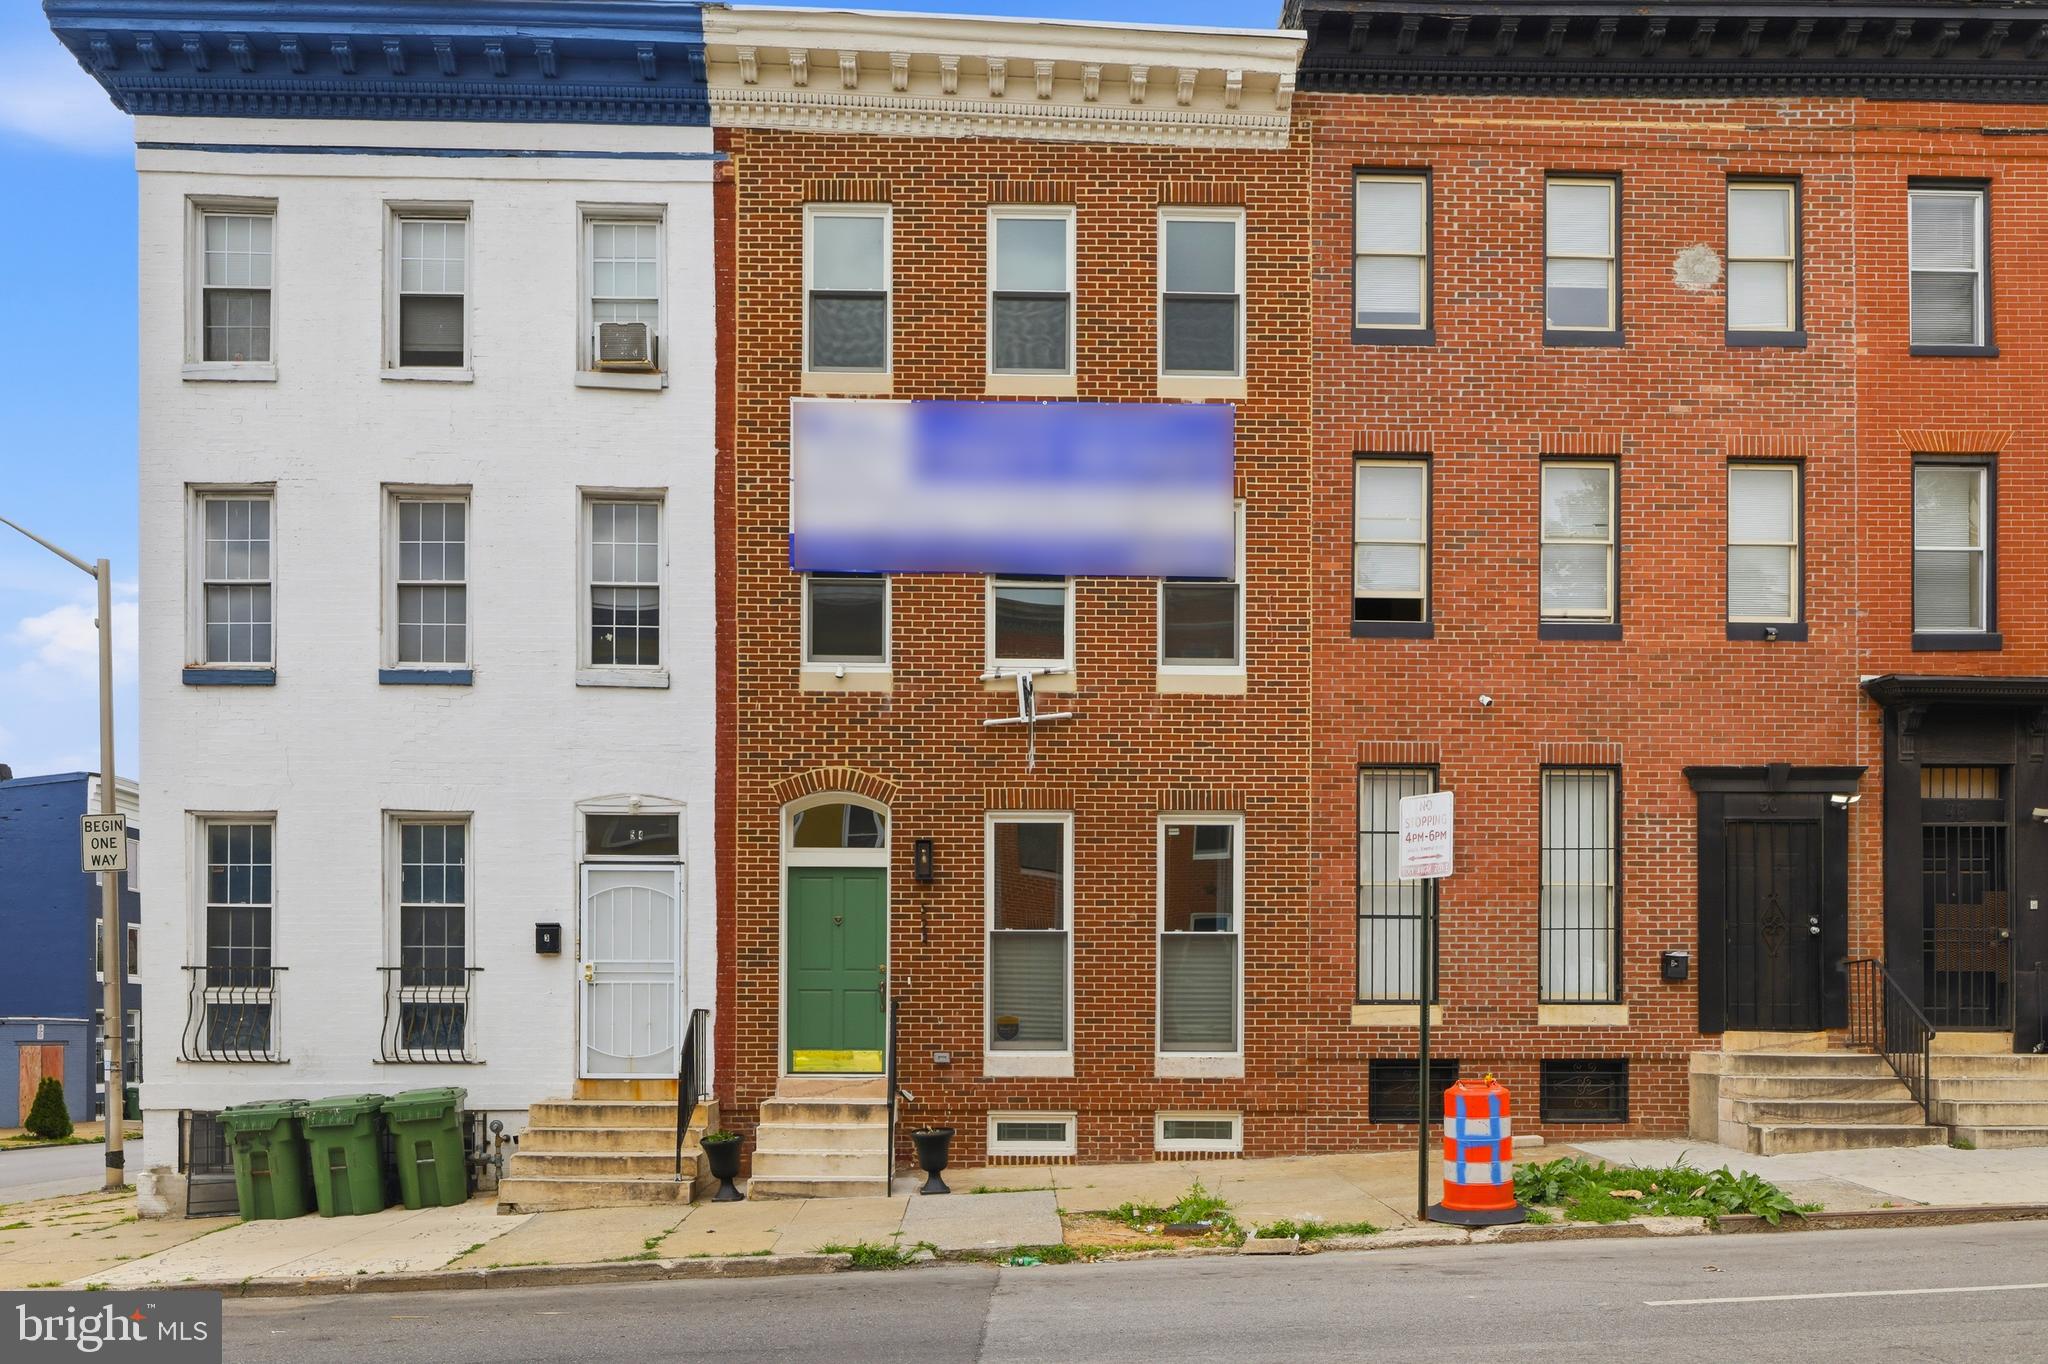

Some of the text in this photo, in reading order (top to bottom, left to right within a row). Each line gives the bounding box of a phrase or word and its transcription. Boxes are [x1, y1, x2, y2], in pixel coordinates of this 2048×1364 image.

[1420, 799, 1433, 812] NO
[84, 820, 123, 832] BEGIN
[91, 837, 118, 849] ONE
[1405, 830, 1447, 844] 4PM-6PM
[91, 854, 118, 866] WAY
